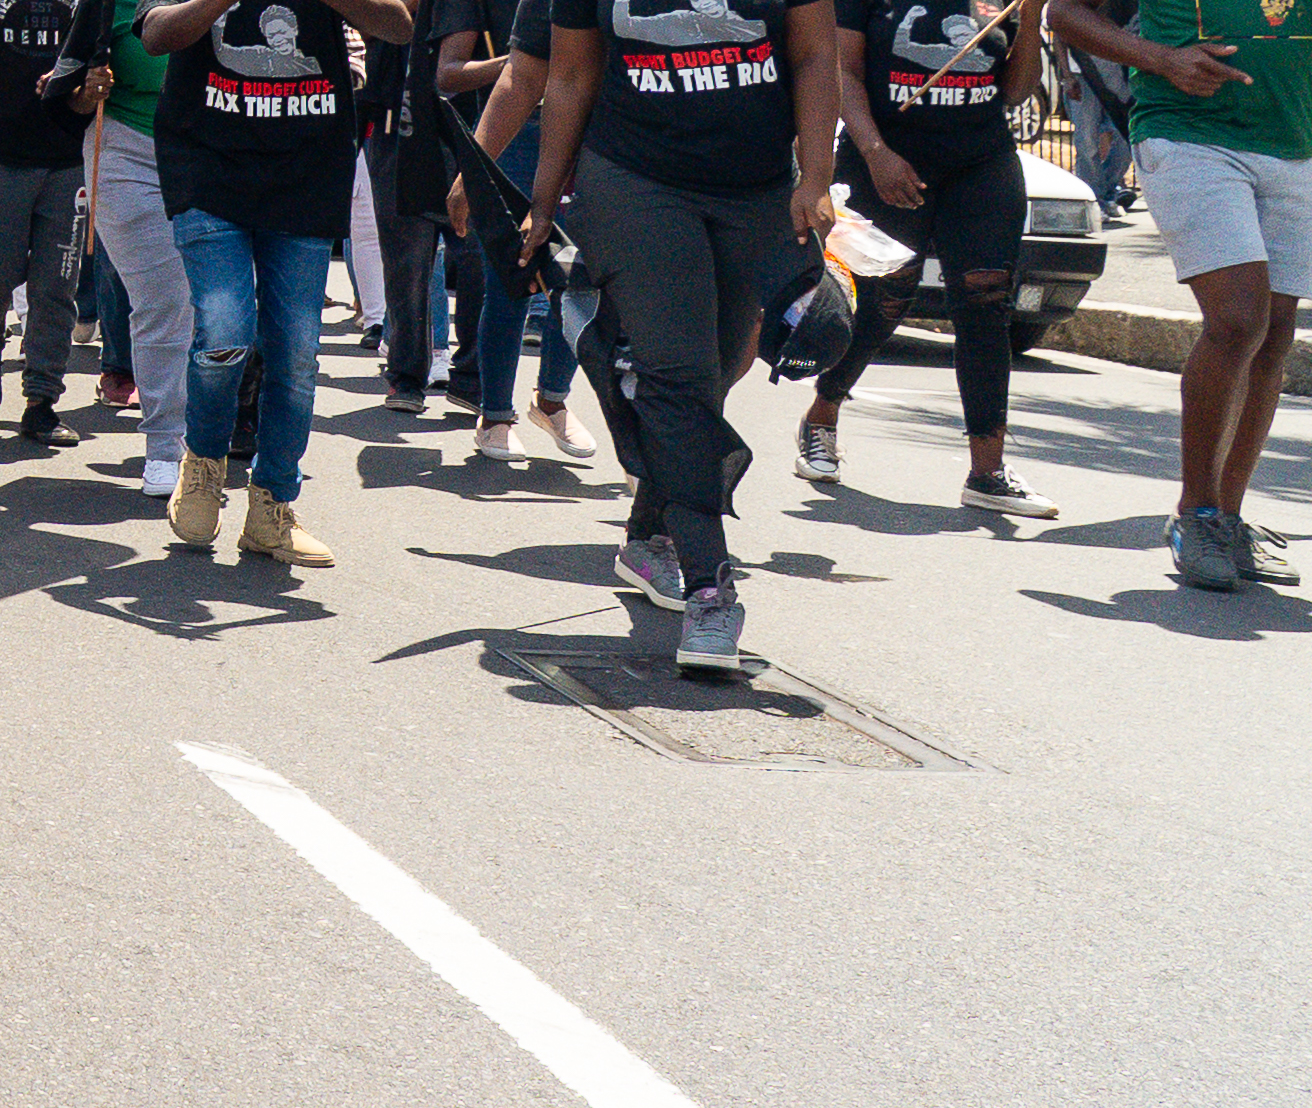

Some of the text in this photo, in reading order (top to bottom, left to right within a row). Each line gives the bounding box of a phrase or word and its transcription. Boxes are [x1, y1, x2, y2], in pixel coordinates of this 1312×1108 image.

[29, 1, 53, 12] EST
[3, 28, 59, 46] DENI
[671, 47, 743, 69] BUDGET
[208, 72, 239, 94] FIGHT
[243, 81, 297, 97] BUDGET
[627, 55, 778, 93] TAX THE RIC
[890, 71, 924, 86] FIGHT
[205, 85, 336, 118] TAX THE RICH
[888, 83, 924, 105] TAX
[929, 87, 965, 106] THE
